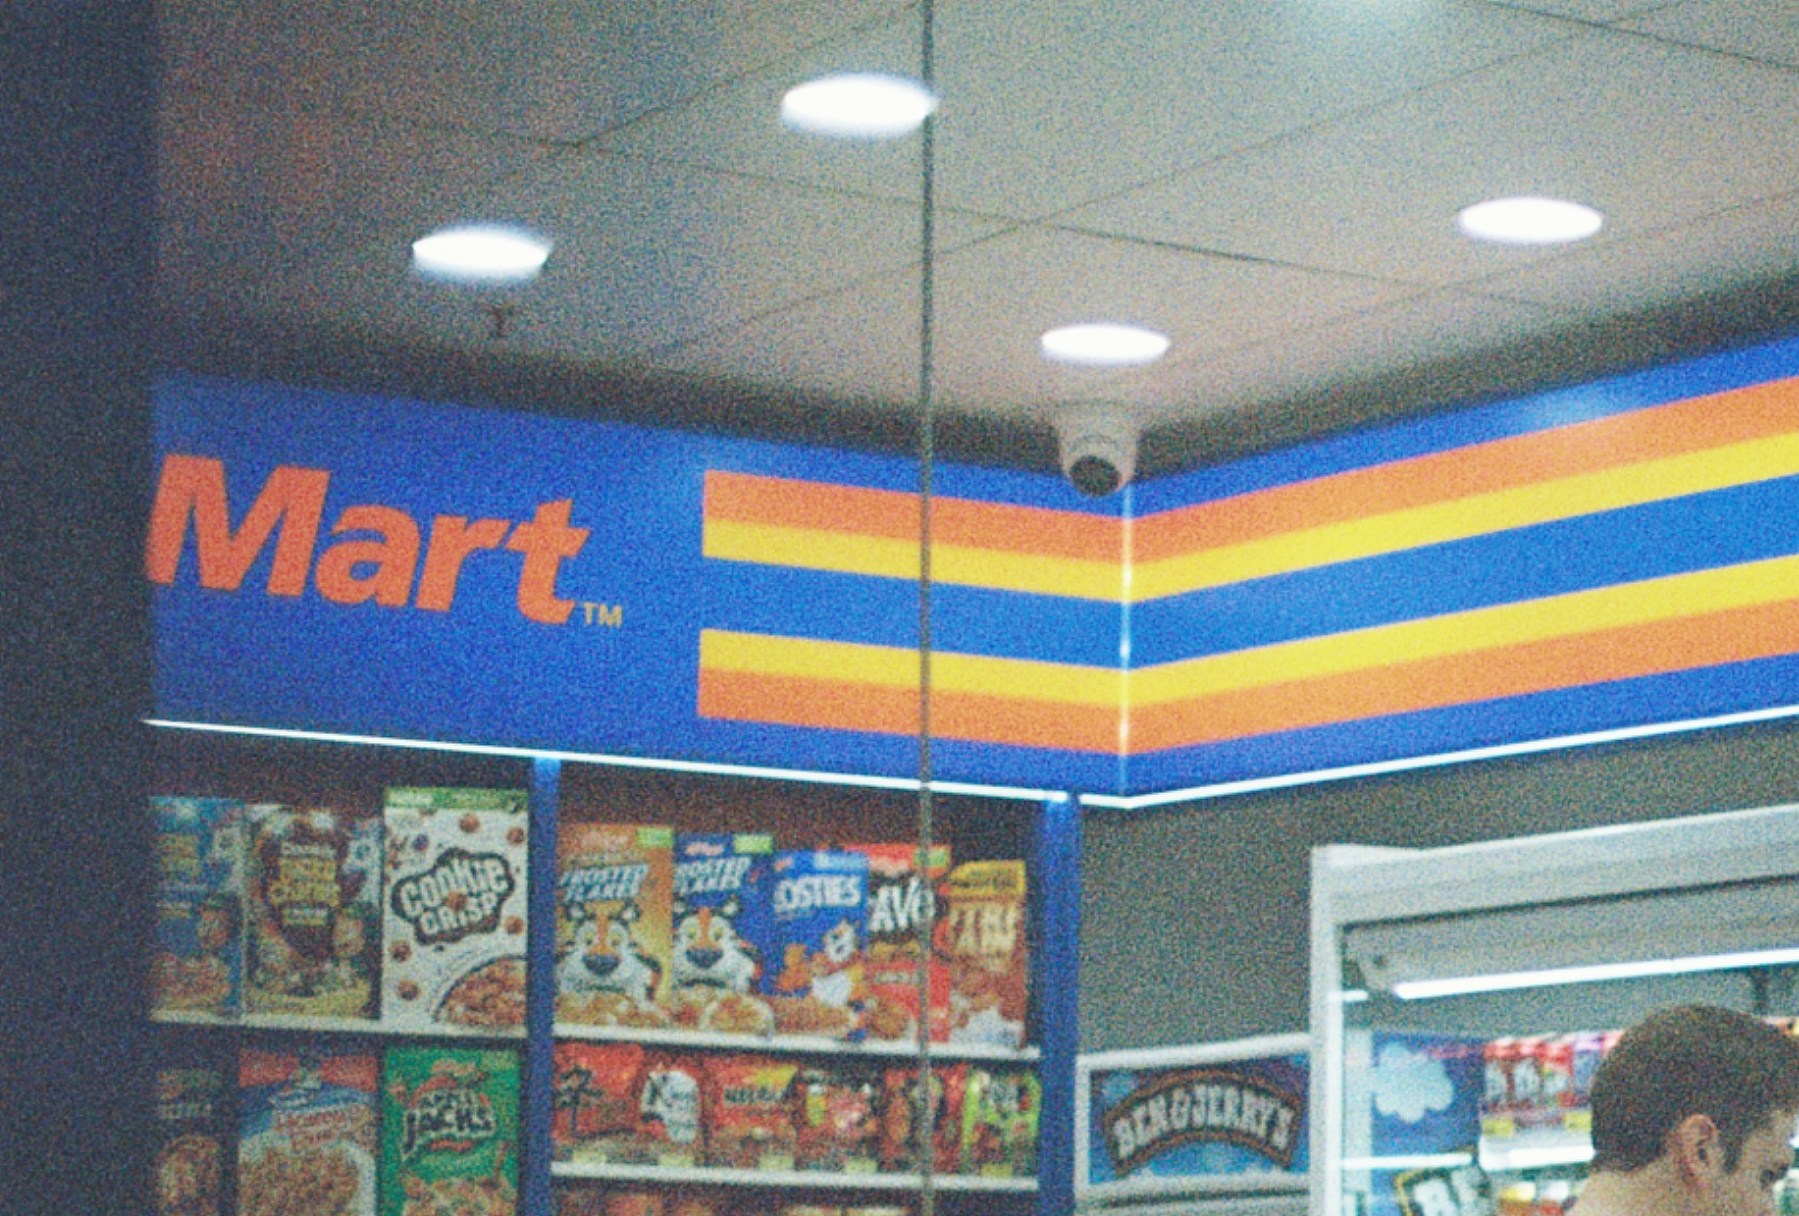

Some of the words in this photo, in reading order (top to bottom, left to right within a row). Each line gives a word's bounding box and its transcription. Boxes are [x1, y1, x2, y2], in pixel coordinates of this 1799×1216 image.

[144, 453, 591, 625] Mart
[399, 856, 510, 918] COOKIE
[774, 874, 862, 914] OSTIES
[1113, 1093, 1170, 1160] BEN
